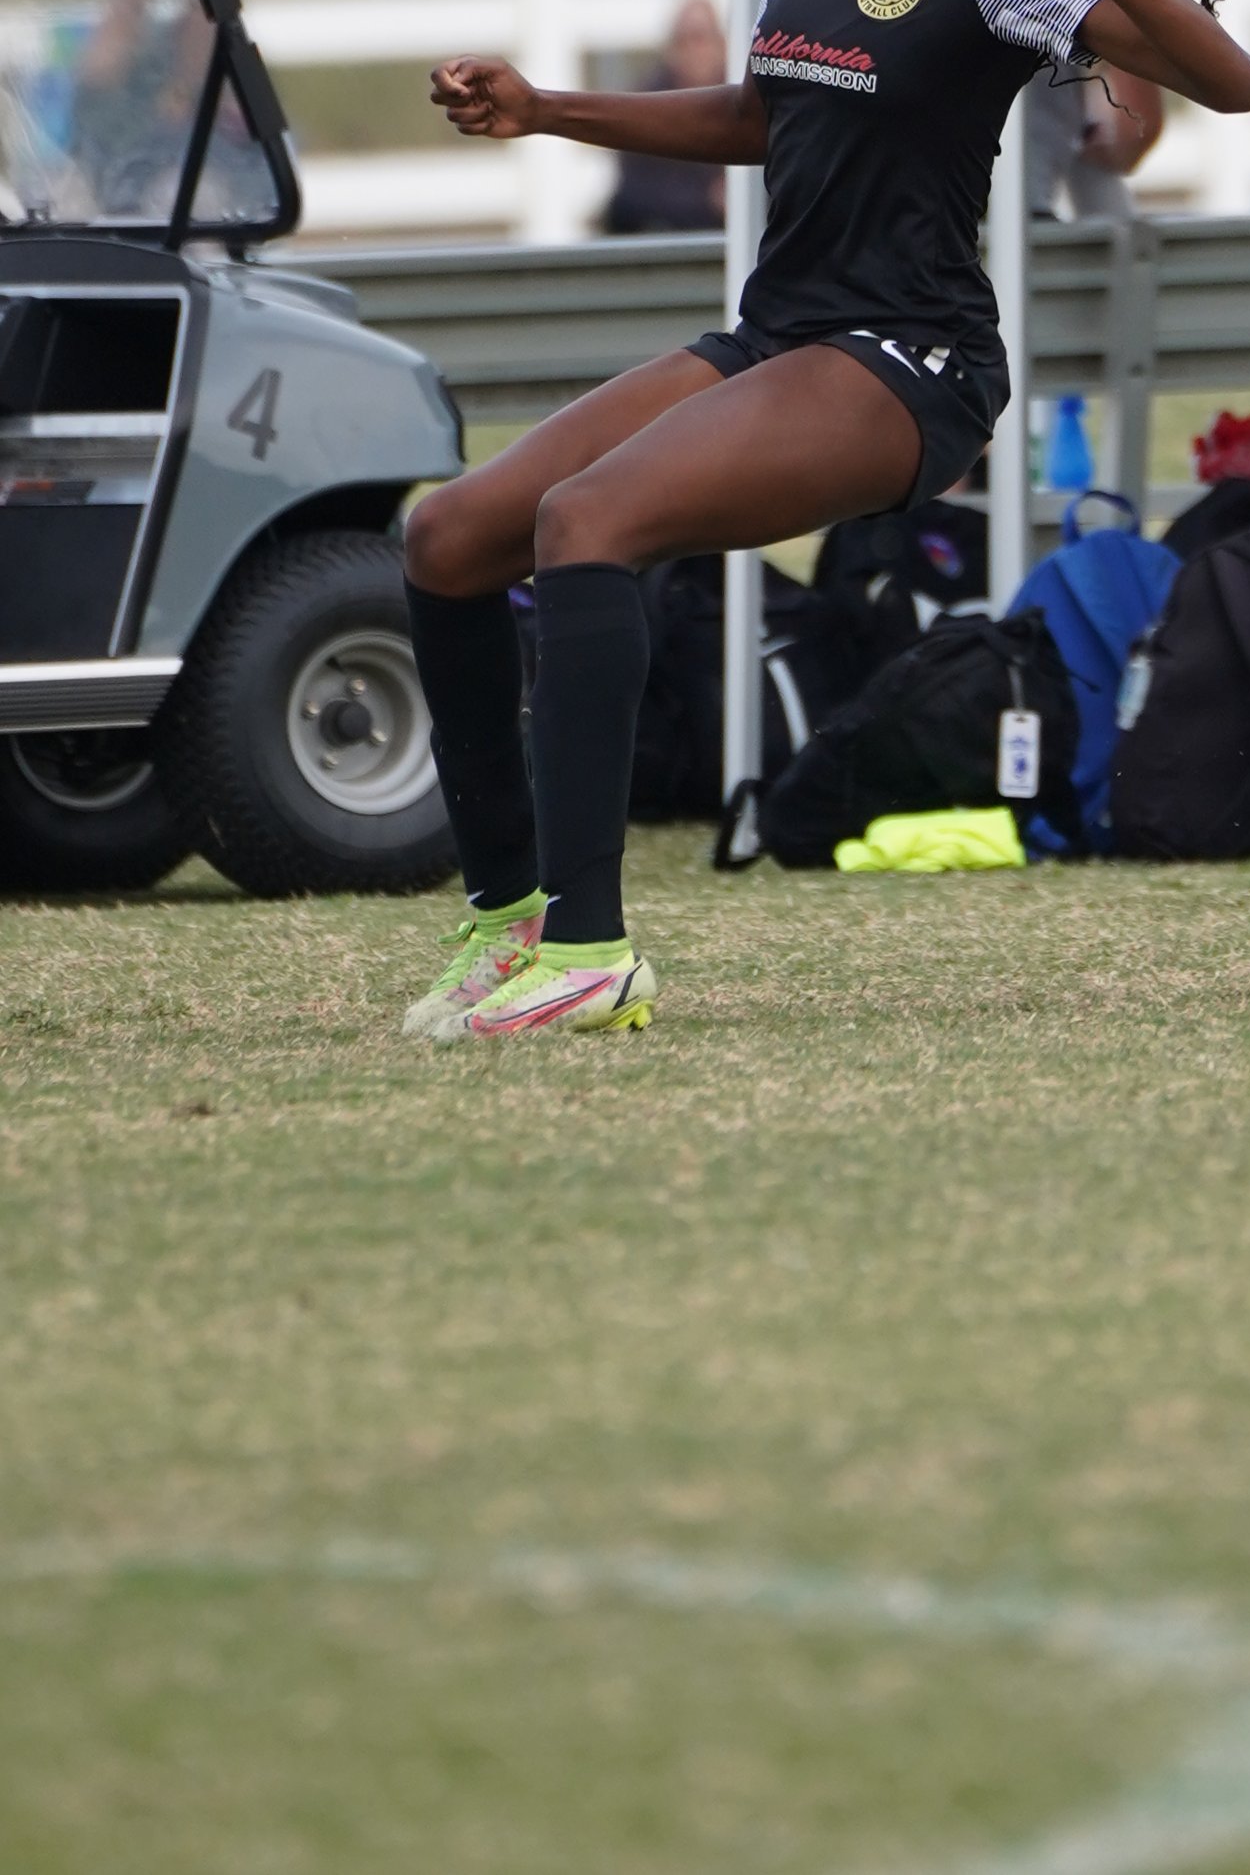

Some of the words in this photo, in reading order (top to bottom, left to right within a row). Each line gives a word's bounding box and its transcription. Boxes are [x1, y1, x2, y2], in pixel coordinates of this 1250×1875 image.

[751, 26, 877, 70] alifornia
[751, 54, 878, 93] ANSMISSION
[228, 367, 284, 461] 4
